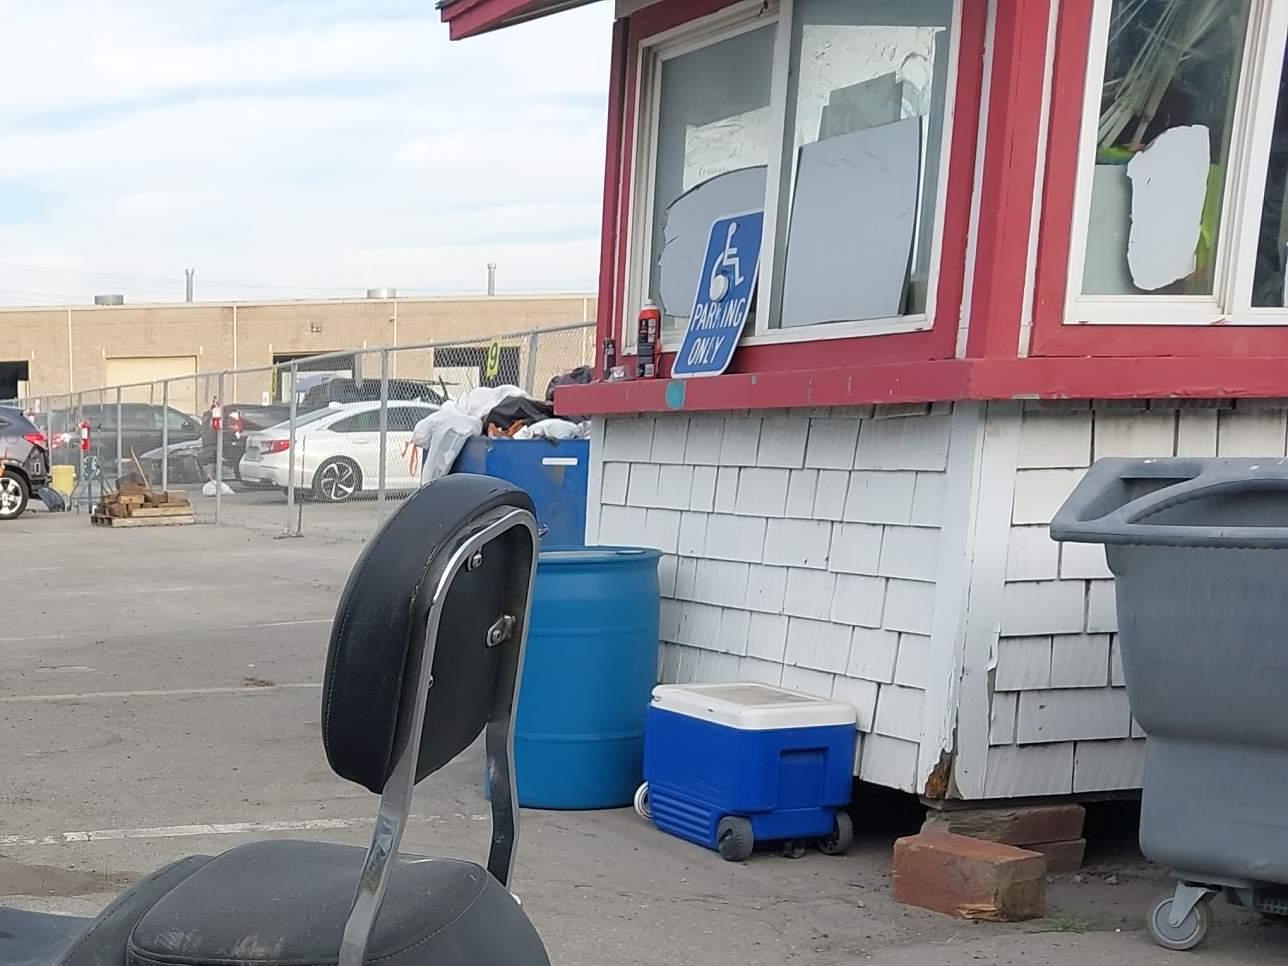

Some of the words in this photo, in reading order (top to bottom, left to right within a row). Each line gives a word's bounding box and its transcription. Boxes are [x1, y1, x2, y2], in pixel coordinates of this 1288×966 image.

[691, 298, 745, 331] PARKING
[490, 342, 498, 369] 9
[688, 336, 725, 365] ONLY
